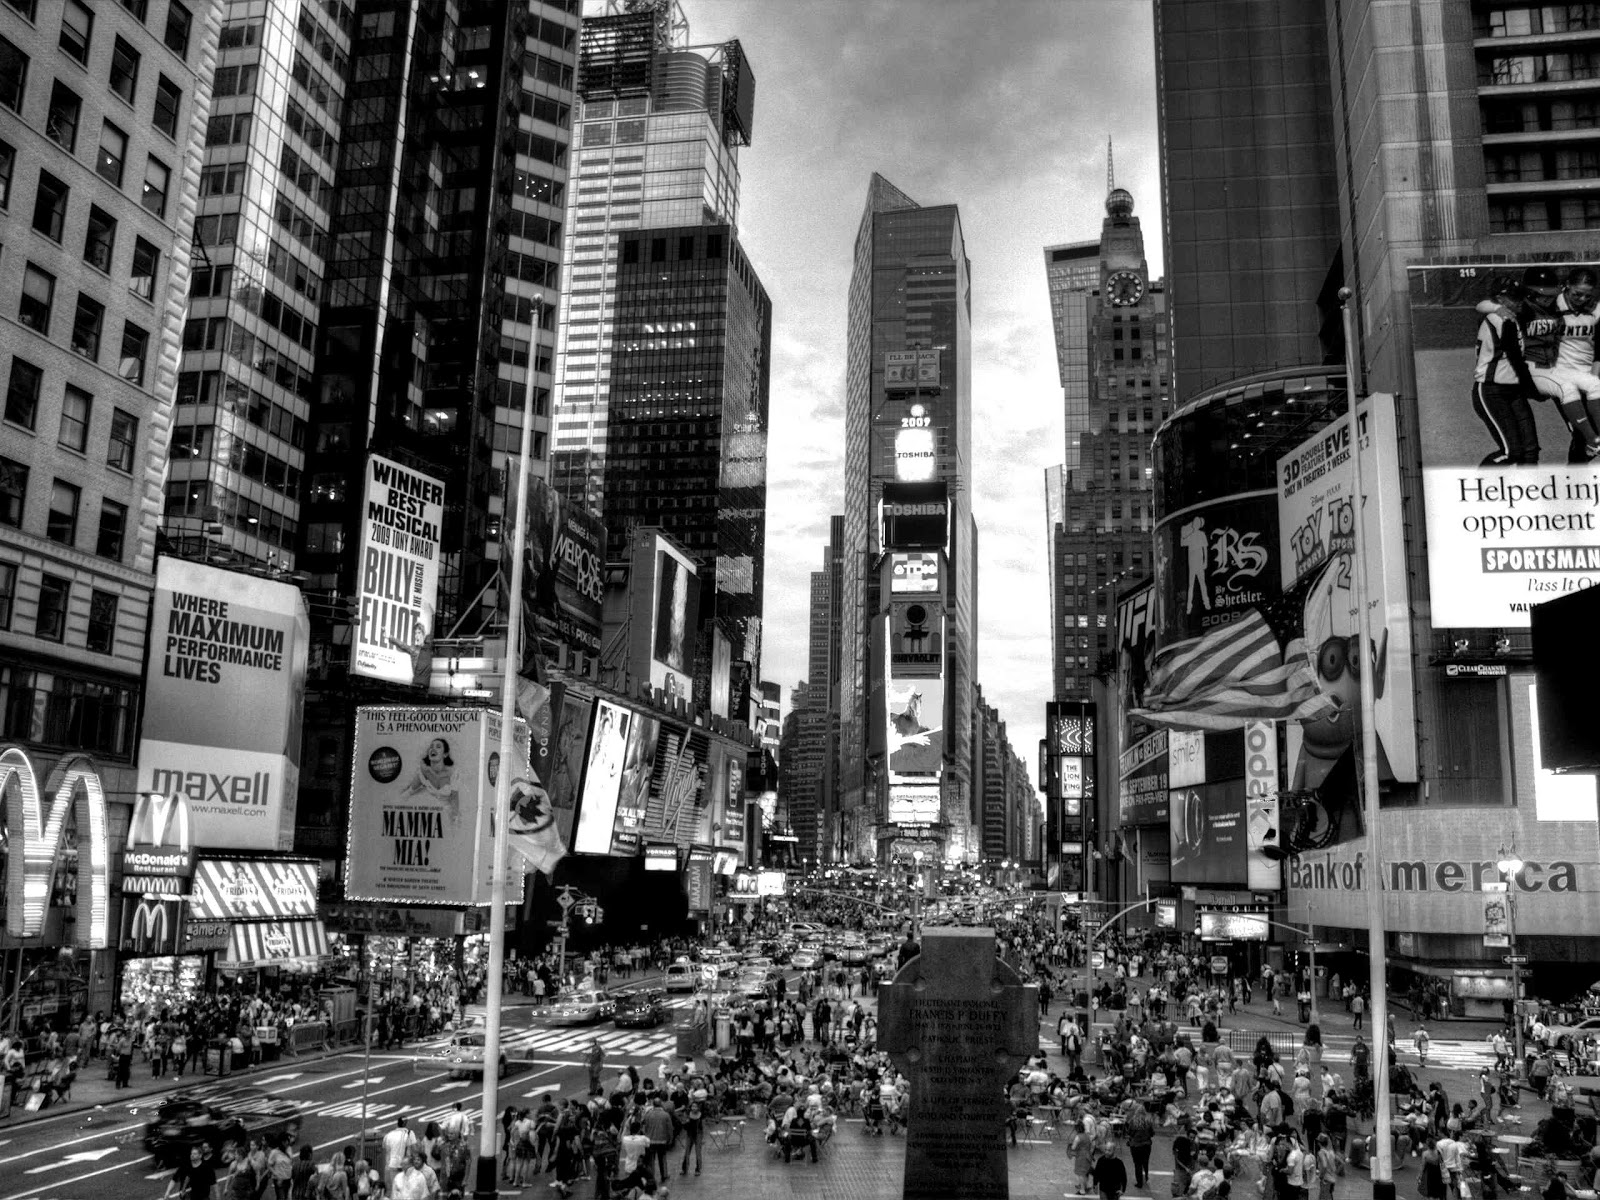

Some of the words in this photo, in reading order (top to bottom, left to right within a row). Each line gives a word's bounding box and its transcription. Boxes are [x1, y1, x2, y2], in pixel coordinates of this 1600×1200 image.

[1526, 318, 1555, 337] WEST
[901, 417, 931, 428] 2009
[1324, 410, 1368, 459] EVET
[1300, 439, 1325, 464] DOUBLE
[1301, 452, 1325, 475] FEATURE
[373, 459, 443, 507] WINNER
[1283, 459, 1300, 486] 3D
[1283, 482, 1296, 499] ONLY
[1302, 463, 1326, 487] THEATRES
[387, 487, 427, 518] BEST
[1457, 474, 1558, 508] Helped
[367, 501, 439, 543] MUSICAL
[884, 503, 946, 516] TOSHIBA
[1290, 506, 1323, 564] TOY
[1462, 512, 1596, 539] opponent
[371, 522, 391, 545] 2009
[391, 529, 409, 552] TONY
[409, 535, 434, 560] AWARD
[555, 533, 601, 579] MELROSE
[363, 546, 416, 605] BILLY
[413, 563, 424, 595] MUSICAL
[576, 570, 603, 605] PLACE
[1528, 578, 1558, 591] Pass
[1562, 577, 1574, 591] It
[172, 591, 229, 618] WHERE
[412, 594, 422, 608] THE
[1215, 590, 1263, 607] Sheckler
[168, 610, 285, 654] MAXIMUM
[360, 596, 421, 651] ELLIOT
[166, 635, 283, 671] PERFORMANCE
[163, 654, 222, 684] LIVES
[376, 722, 385, 732] IS
[387, 723, 394, 732] A
[389, 711, 438, 722] FEEL-GOOD
[440, 711, 480, 722] MUSICAL
[1063, 771, 1080, 783] LION
[1066, 764, 1077, 772] THE
[1248, 720, 1276, 822] odak
[152, 768, 270, 806] maxell
[1063, 782, 1081, 793] KING
[191, 803, 267, 818] ww.maxell.com
[381, 810, 444, 838] MAMMA
[124, 853, 189, 867] McDonald's
[393, 839, 431, 866] MIA!
[133, 865, 177, 874] Restaurant
[1290, 852, 1338, 890] Bank
[1342, 852, 1363, 890] of
[1381, 860, 1578, 893] merca
[1200, 905, 1269, 913] MARQUIS
[909, 1008, 955, 1020] FRANCIS
[969, 1010, 1009, 1021] DUFFY
